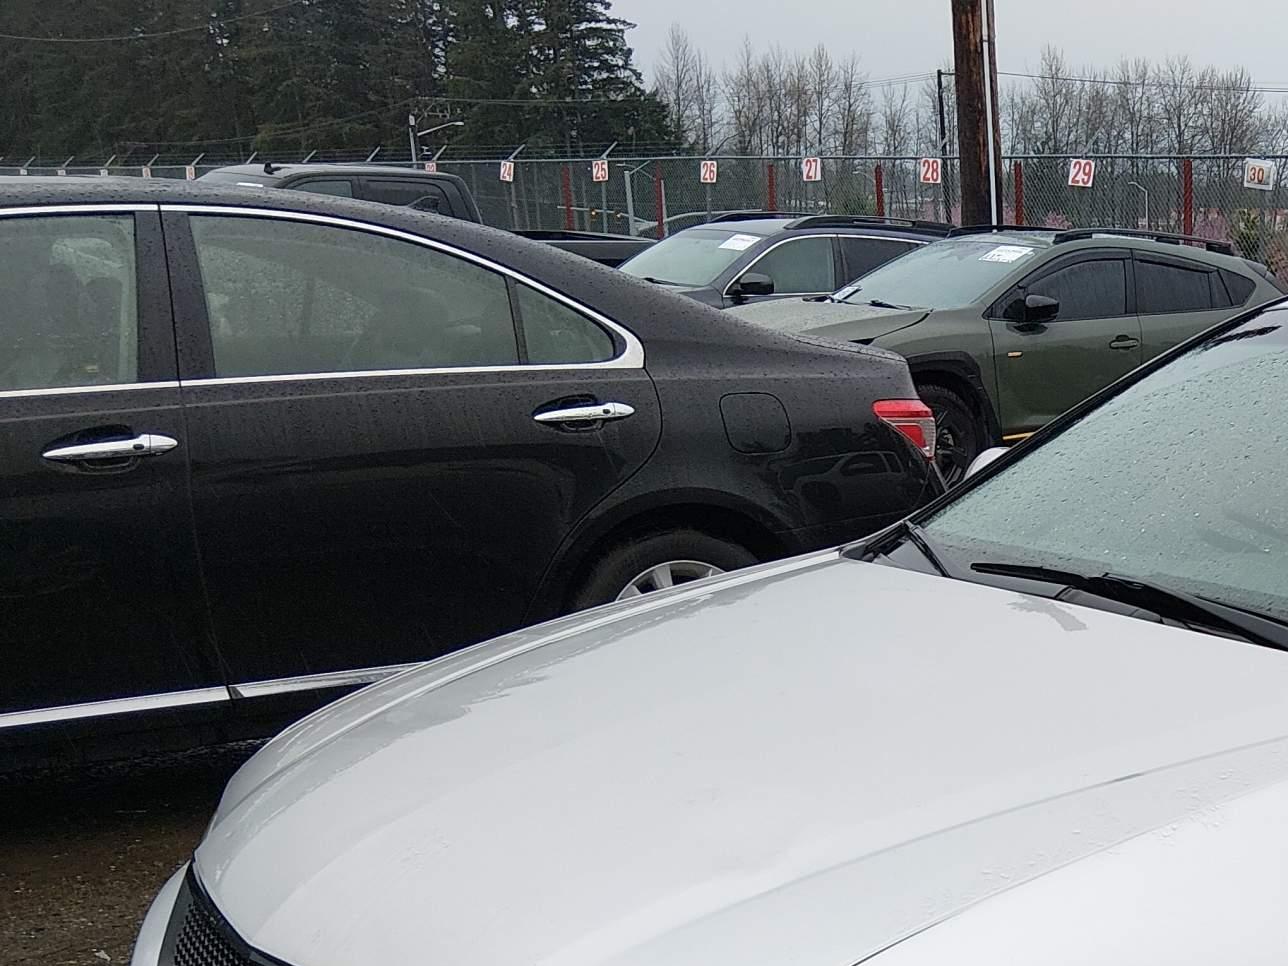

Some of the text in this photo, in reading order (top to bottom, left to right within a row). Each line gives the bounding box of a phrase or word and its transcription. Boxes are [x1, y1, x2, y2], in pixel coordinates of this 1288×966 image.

[502, 163, 513, 180] 24
[594, 162, 607, 180] 25
[702, 162, 716, 181] 26
[805, 159, 818, 180] 27
[922, 159, 939, 182] 28
[1071, 160, 1092, 185] 29
[1249, 166, 1264, 182] 30
